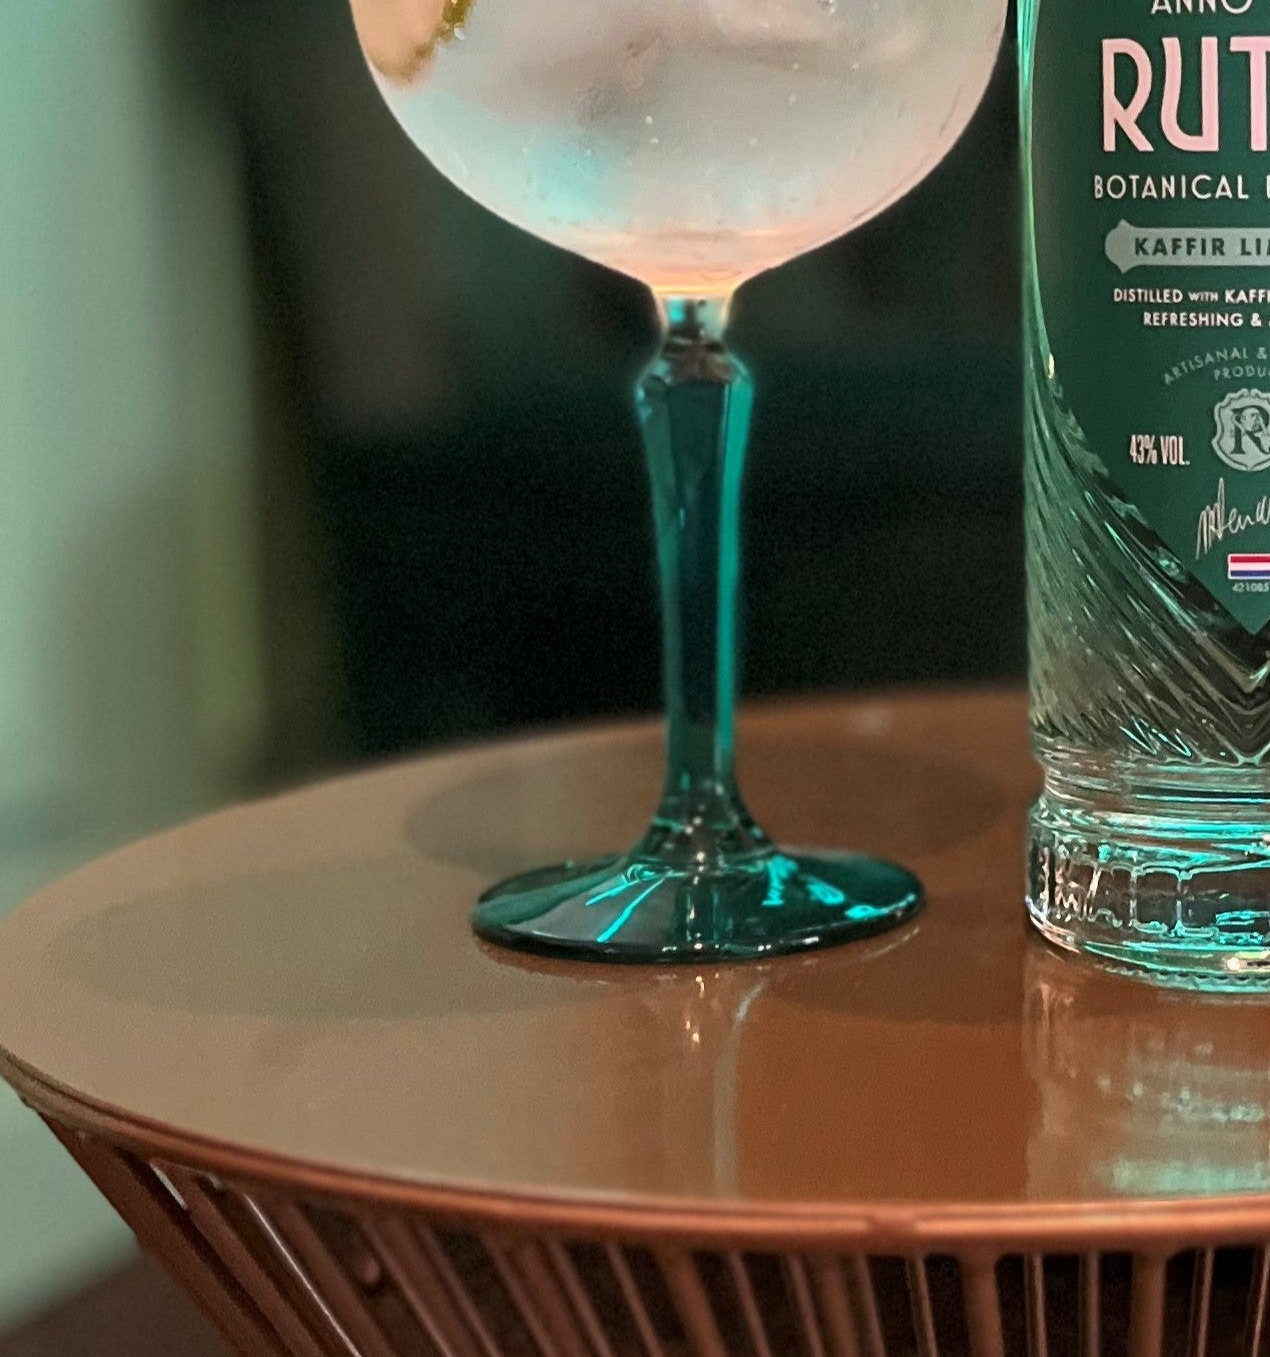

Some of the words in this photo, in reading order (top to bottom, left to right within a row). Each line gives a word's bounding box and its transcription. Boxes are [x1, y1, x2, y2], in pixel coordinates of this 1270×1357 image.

[1094, 174, 1250, 200] BOTANICAL
[1133, 237, 1227, 257] KAFFIR
[1113, 288, 1184, 304] DISTILLED
[1143, 311, 1244, 327] REFRESHING
[1250, 311, 1263, 327] &
[1162, 346, 1250, 387] ARTISANAL
[1256, 346, 1268, 360] &
[1130, 434, 1158, 465] 43%
[1160, 435, 1191, 466] VOL.
